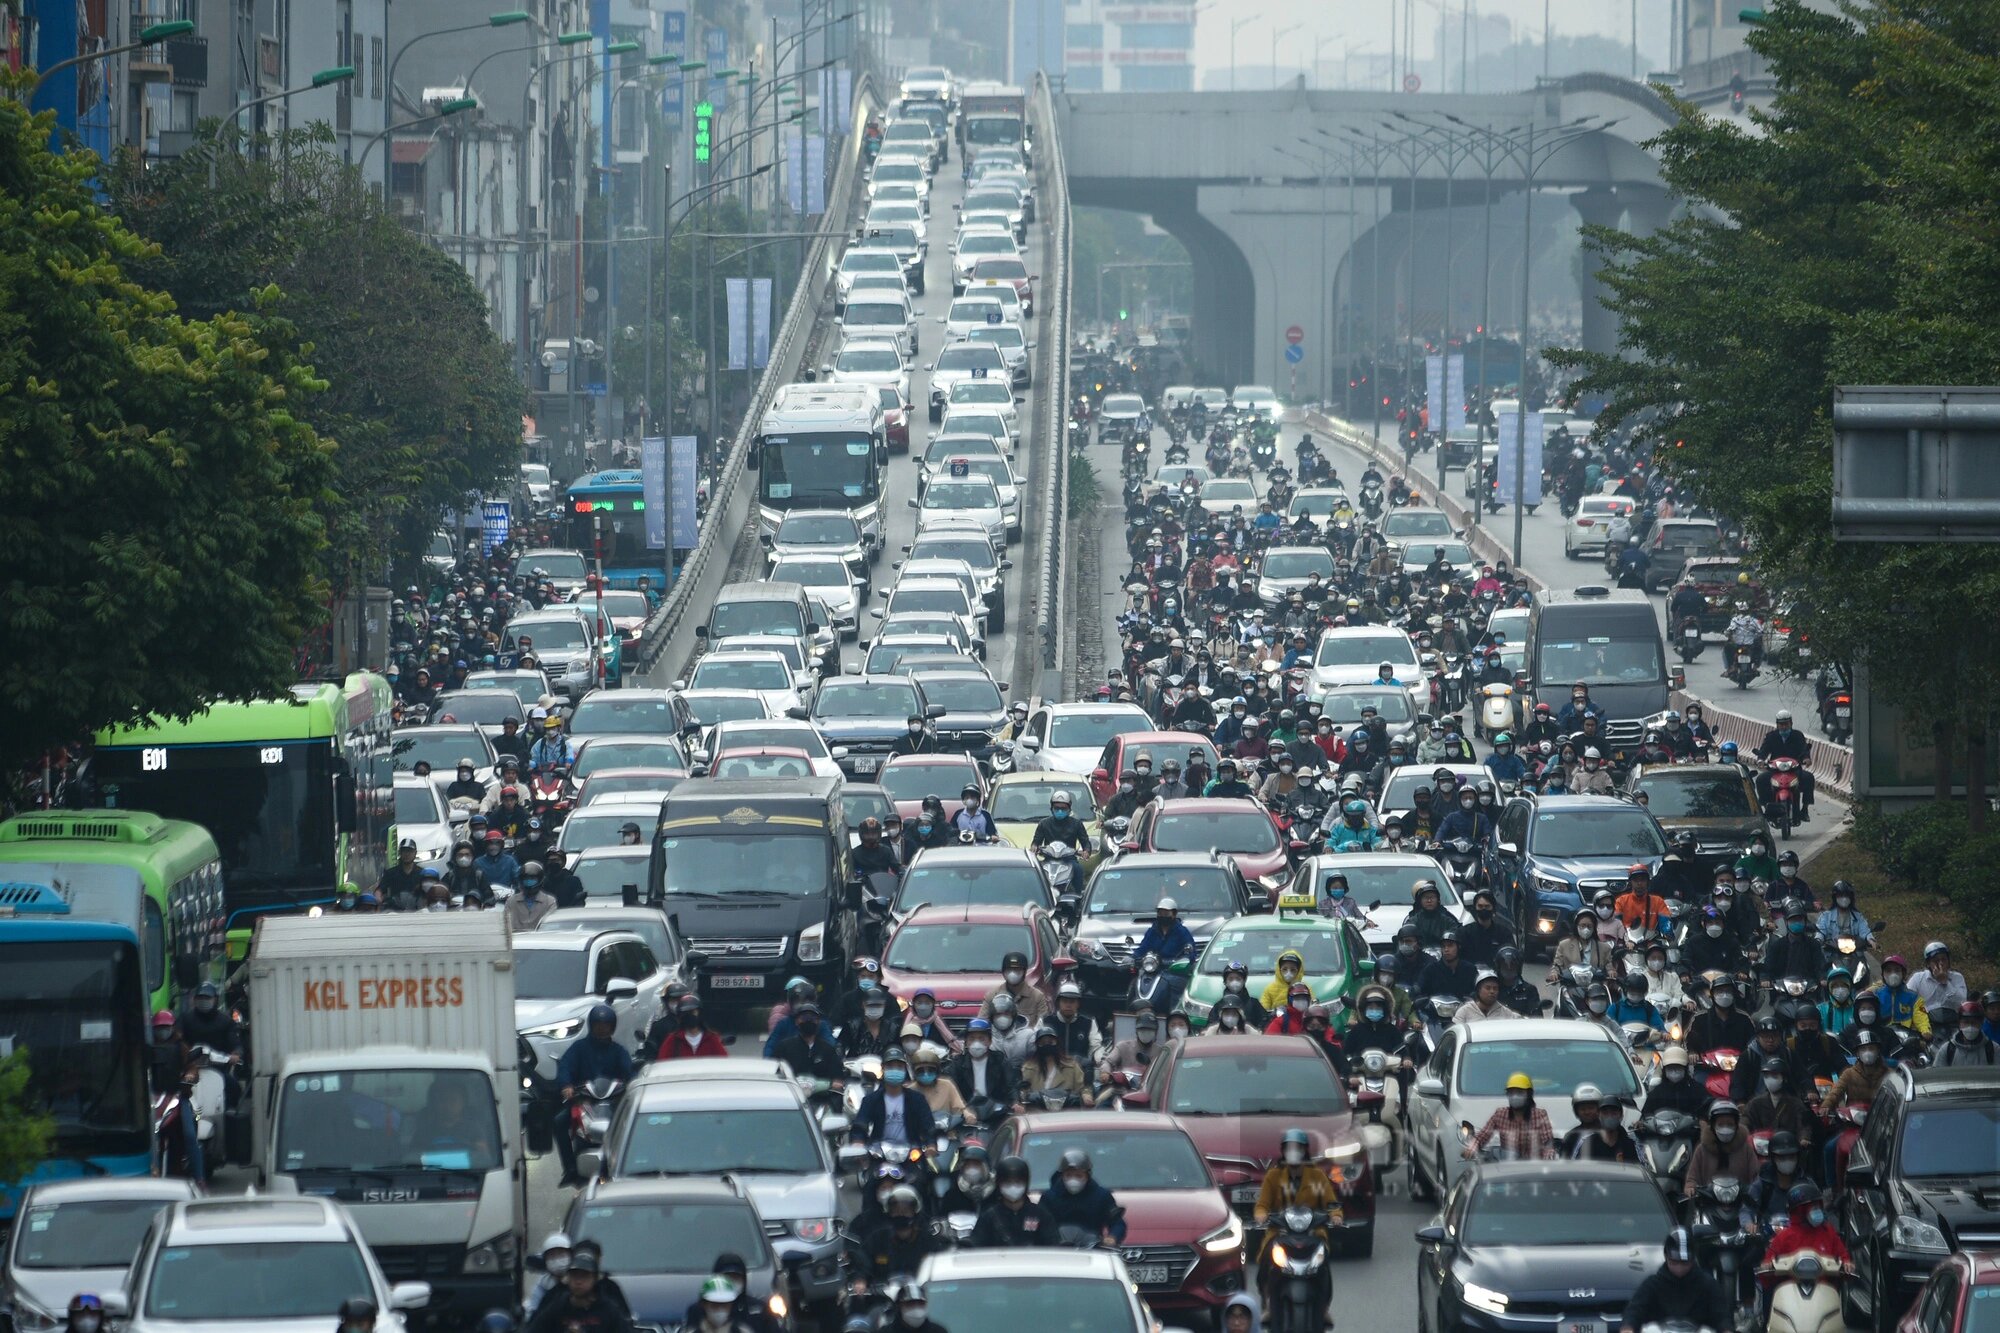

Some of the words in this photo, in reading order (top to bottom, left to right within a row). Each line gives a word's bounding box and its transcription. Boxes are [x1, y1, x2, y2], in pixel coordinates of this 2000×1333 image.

[484, 505, 506, 516] NHÀ
[483, 517, 508, 529] NGHỈ
[500, 656, 511, 668] G7
[142, 748, 167, 770] E01
[304, 981, 348, 1011] KGL
[359, 976, 463, 1009] EXPRESS
[362, 1190, 419, 1202] ISUZU
